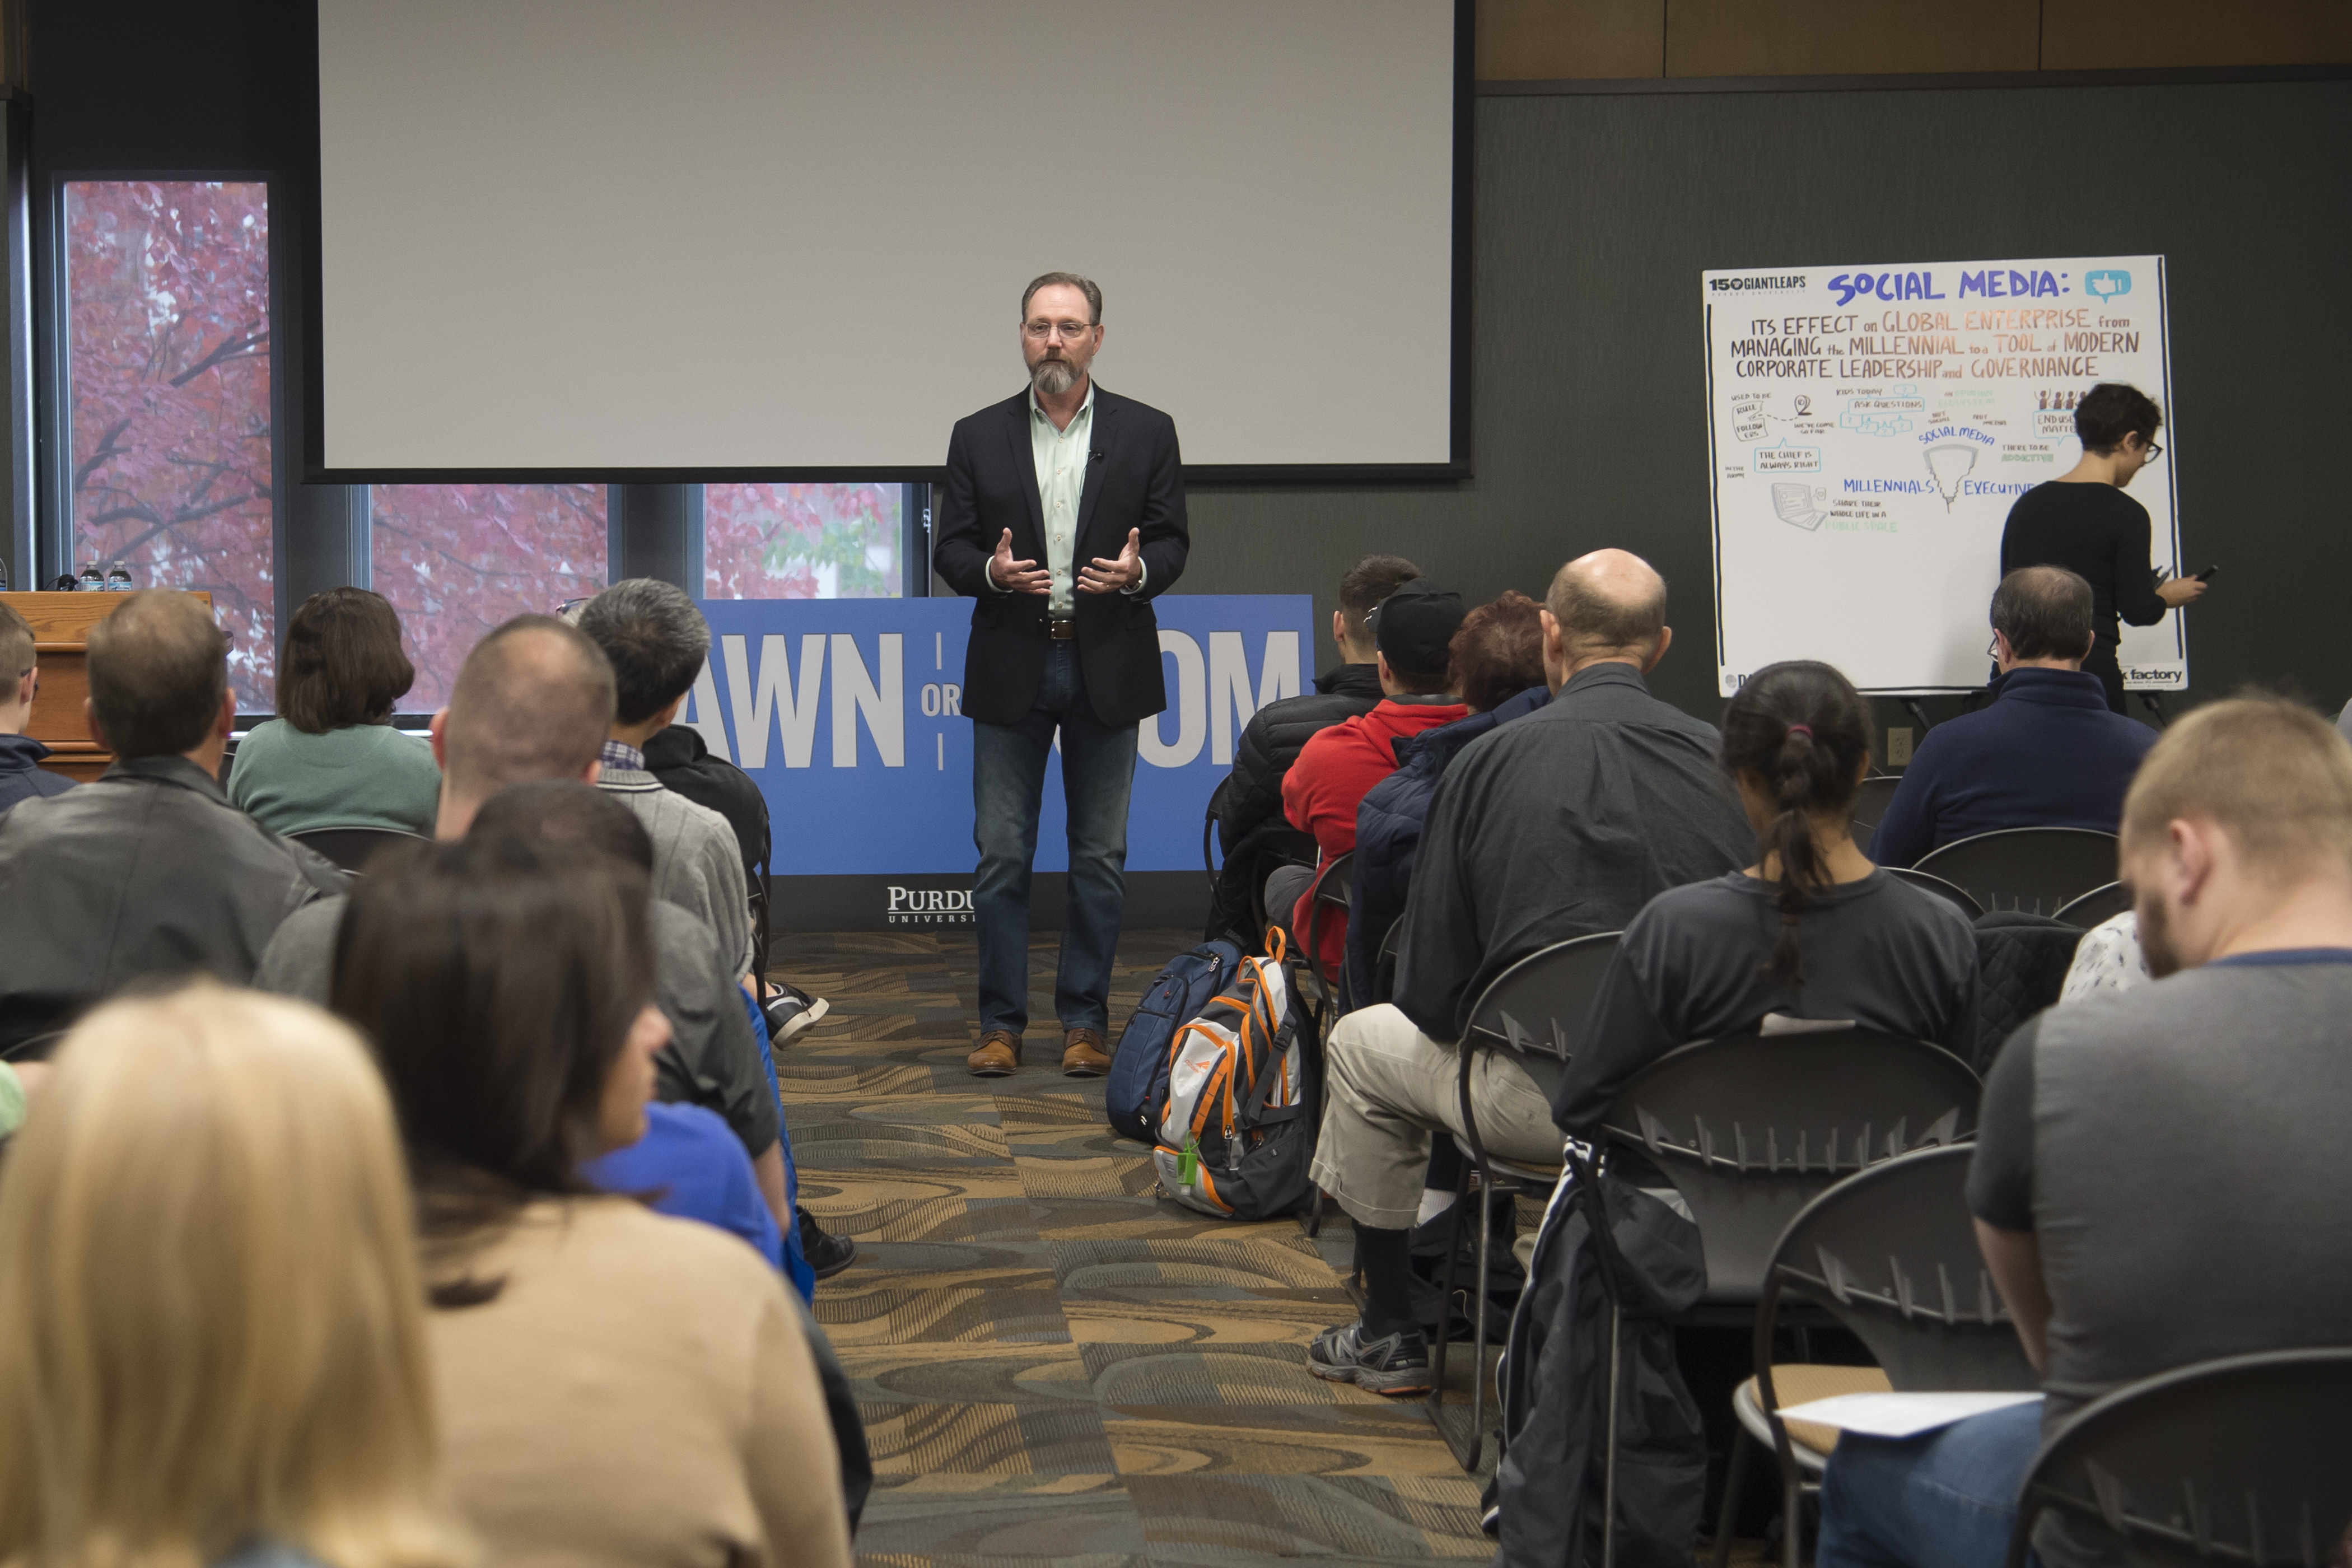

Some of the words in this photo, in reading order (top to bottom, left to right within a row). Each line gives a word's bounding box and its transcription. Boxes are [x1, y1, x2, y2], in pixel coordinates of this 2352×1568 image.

[1827, 272, 1945, 306] SOCIAL
[1959, 269, 2070, 298] MEDIA:
[1752, 319, 1776, 335] ITS
[1784, 315, 1859, 334] EFFECT
[1864, 322, 1878, 332] on
[1882, 311, 1958, 333] GLOBAL
[1964, 309, 2091, 330] ENTERPRISE
[2099, 316, 2130, 328] from
[1731, 336, 1821, 358] MANAGING
[1827, 344, 1845, 356] the
[1849, 335, 1964, 356] MILLENNIAL
[1992, 333, 2042, 353] TOOL
[2064, 332, 2139, 353] MODERN
[1736, 359, 1833, 379] CORPORATE
[1840, 358, 1943, 379] LEADERSHIP
[1942, 364, 1963, 379] and
[1971, 356, 2099, 379] GOVERNANCE
[1737, 404, 1756, 414] RULE
[1854, 400, 1871, 409] ASK
[1874, 400, 1922, 409] QUESTIONS
[2038, 414, 2057, 424] END
[2058, 414, 2074, 423] USE
[2042, 424, 2075, 434] MATTE
[1919, 426, 1957, 444] SOCIAL
[1959, 427, 1995, 446] MEDIA
[1844, 479, 1934, 494] MILLENNIALS
[1964, 480, 2035, 495] EXECUTIV
[2130, 669, 2182, 683] factory
[674, 633, 905, 768] AWN
[921, 683, 961, 717] OR
[1137, 629, 1300, 768] OM
[887, 886, 974, 911] PURDU
